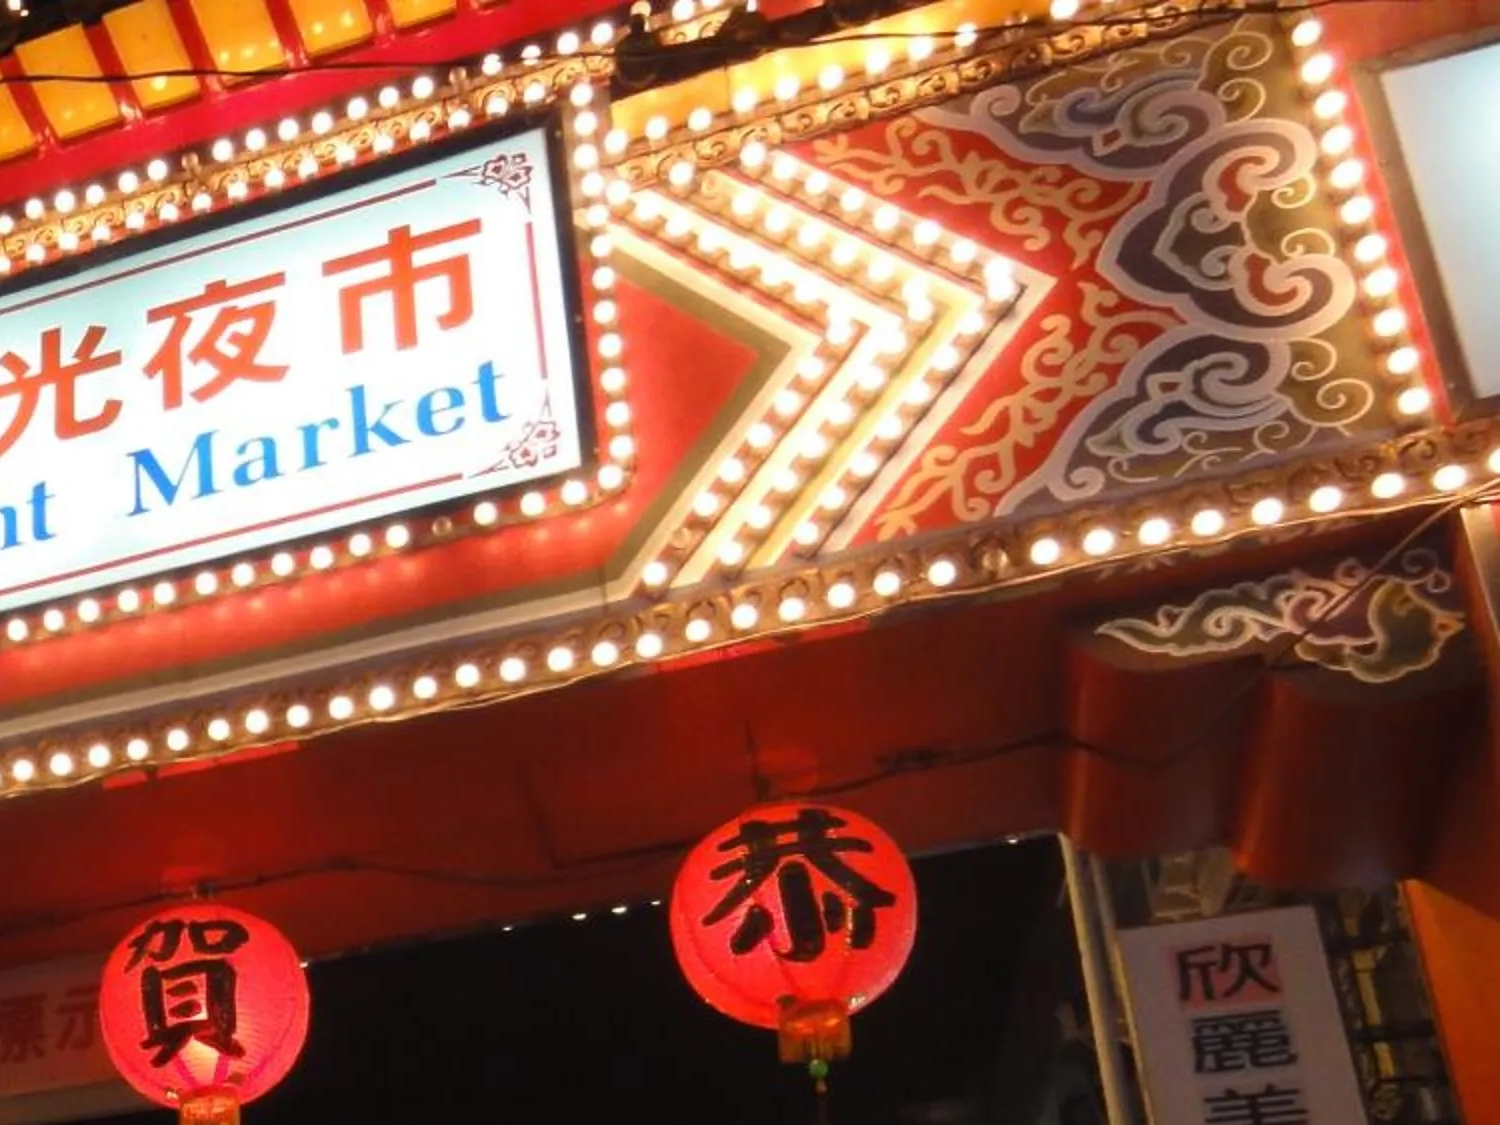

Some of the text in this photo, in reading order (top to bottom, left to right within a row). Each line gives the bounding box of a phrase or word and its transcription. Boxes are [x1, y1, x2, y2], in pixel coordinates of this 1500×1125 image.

[125, 360, 509, 517] Market
[702, 808, 895, 964] 恭
[127, 917, 249, 1068] 賀
